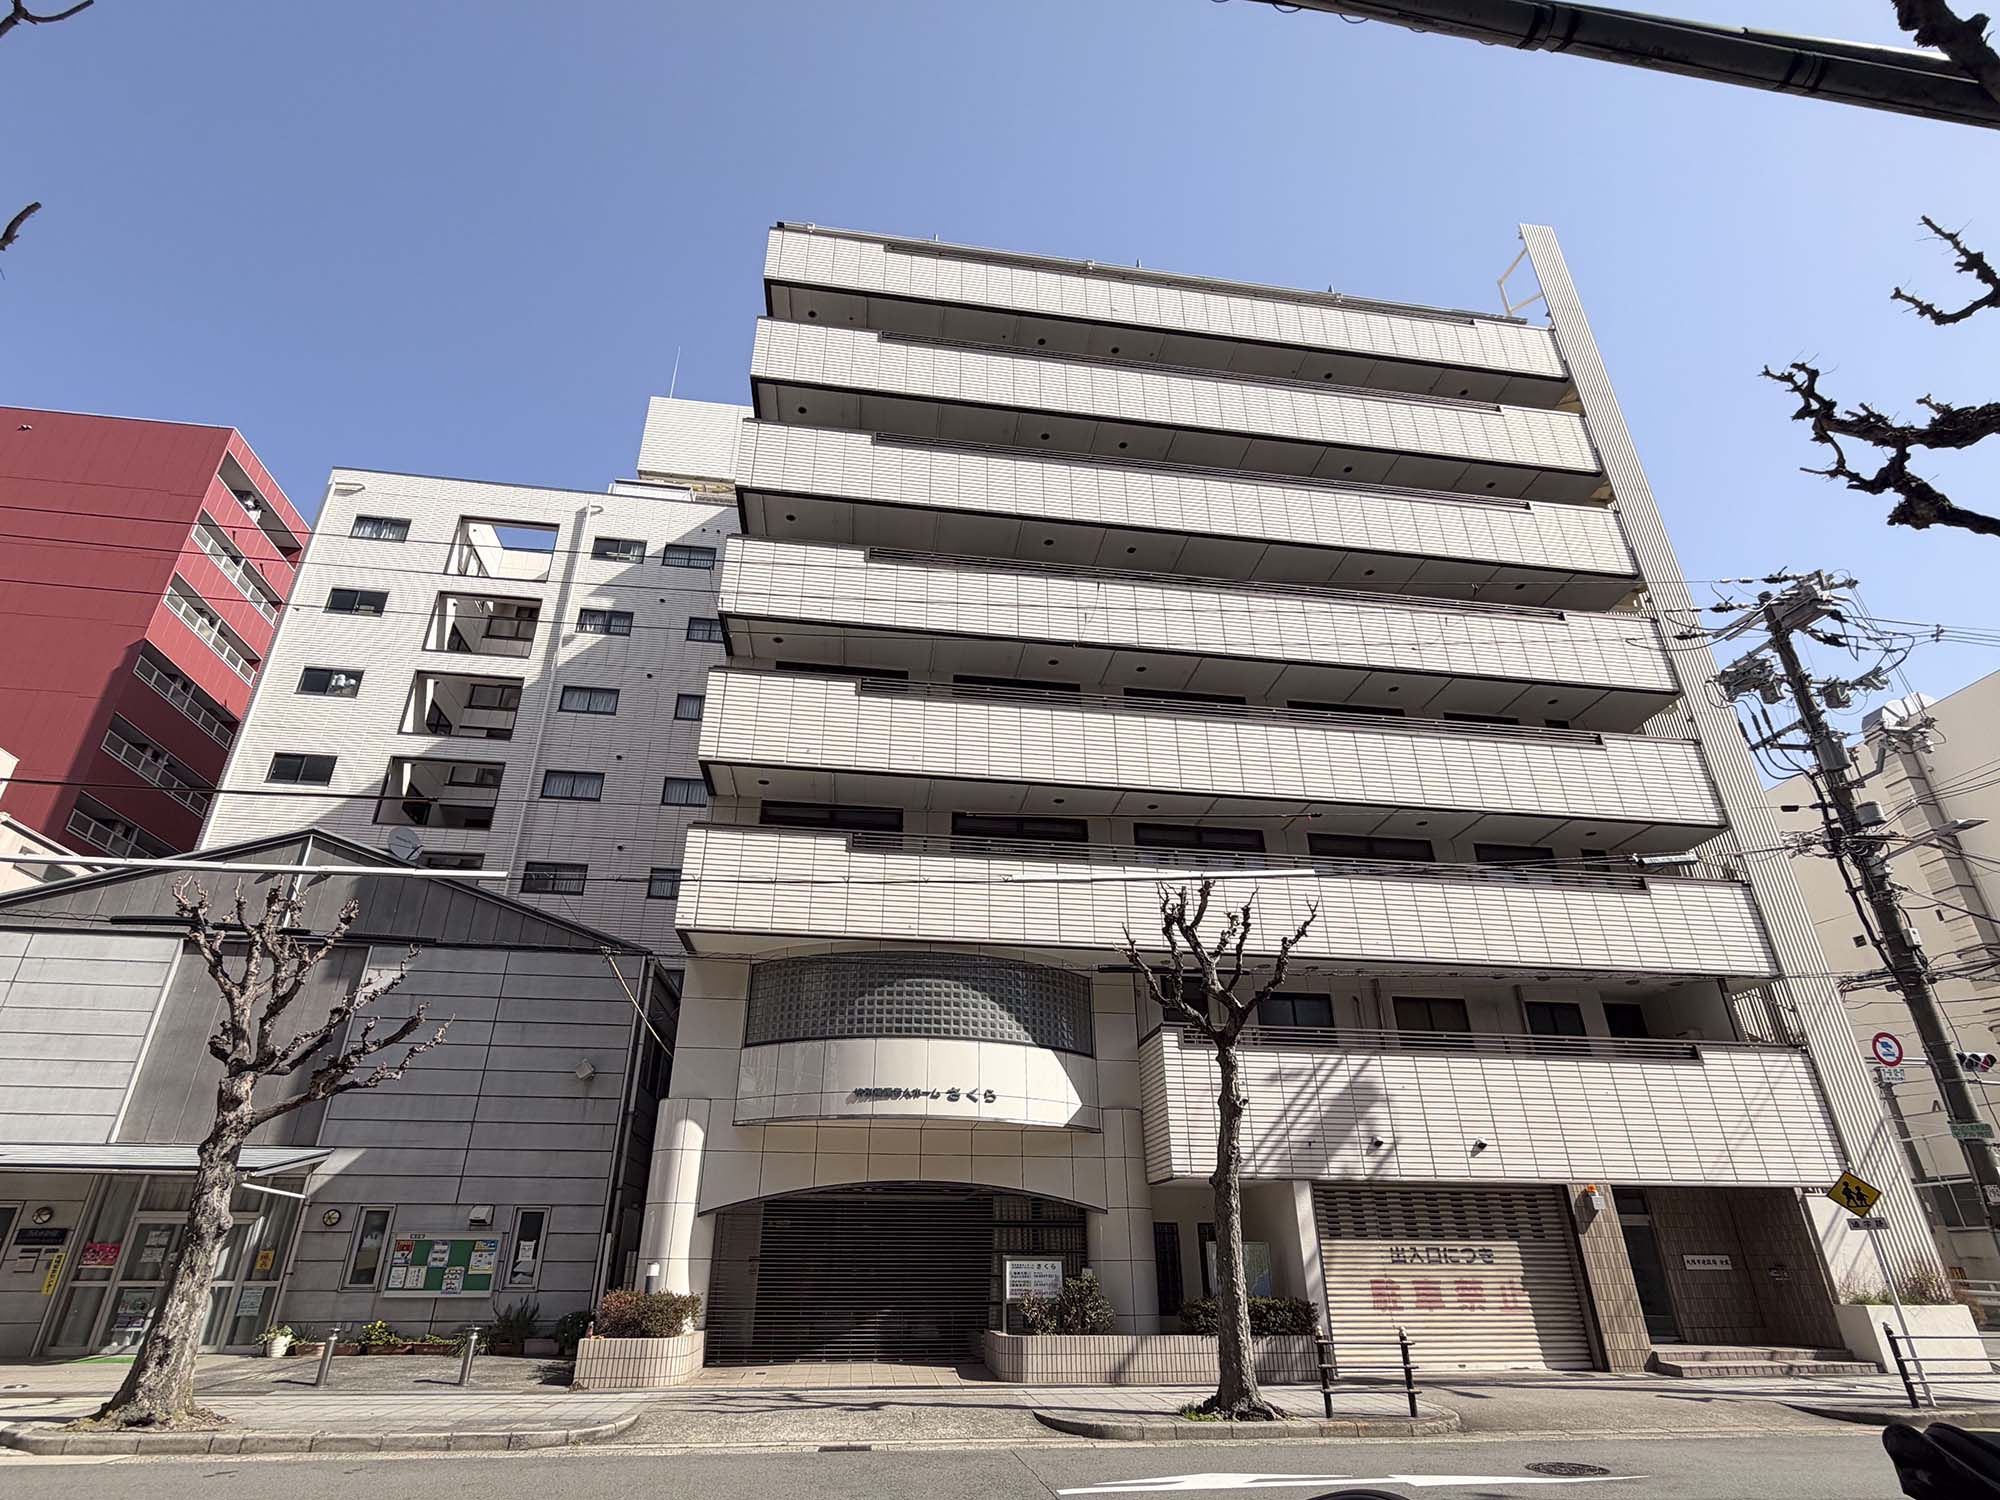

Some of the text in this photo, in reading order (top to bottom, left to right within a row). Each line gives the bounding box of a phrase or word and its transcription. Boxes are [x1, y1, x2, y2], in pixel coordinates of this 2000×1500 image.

[946, 1086, 997, 1103] さくら
[1390, 1247, 1494, 1265] 出入口につき
